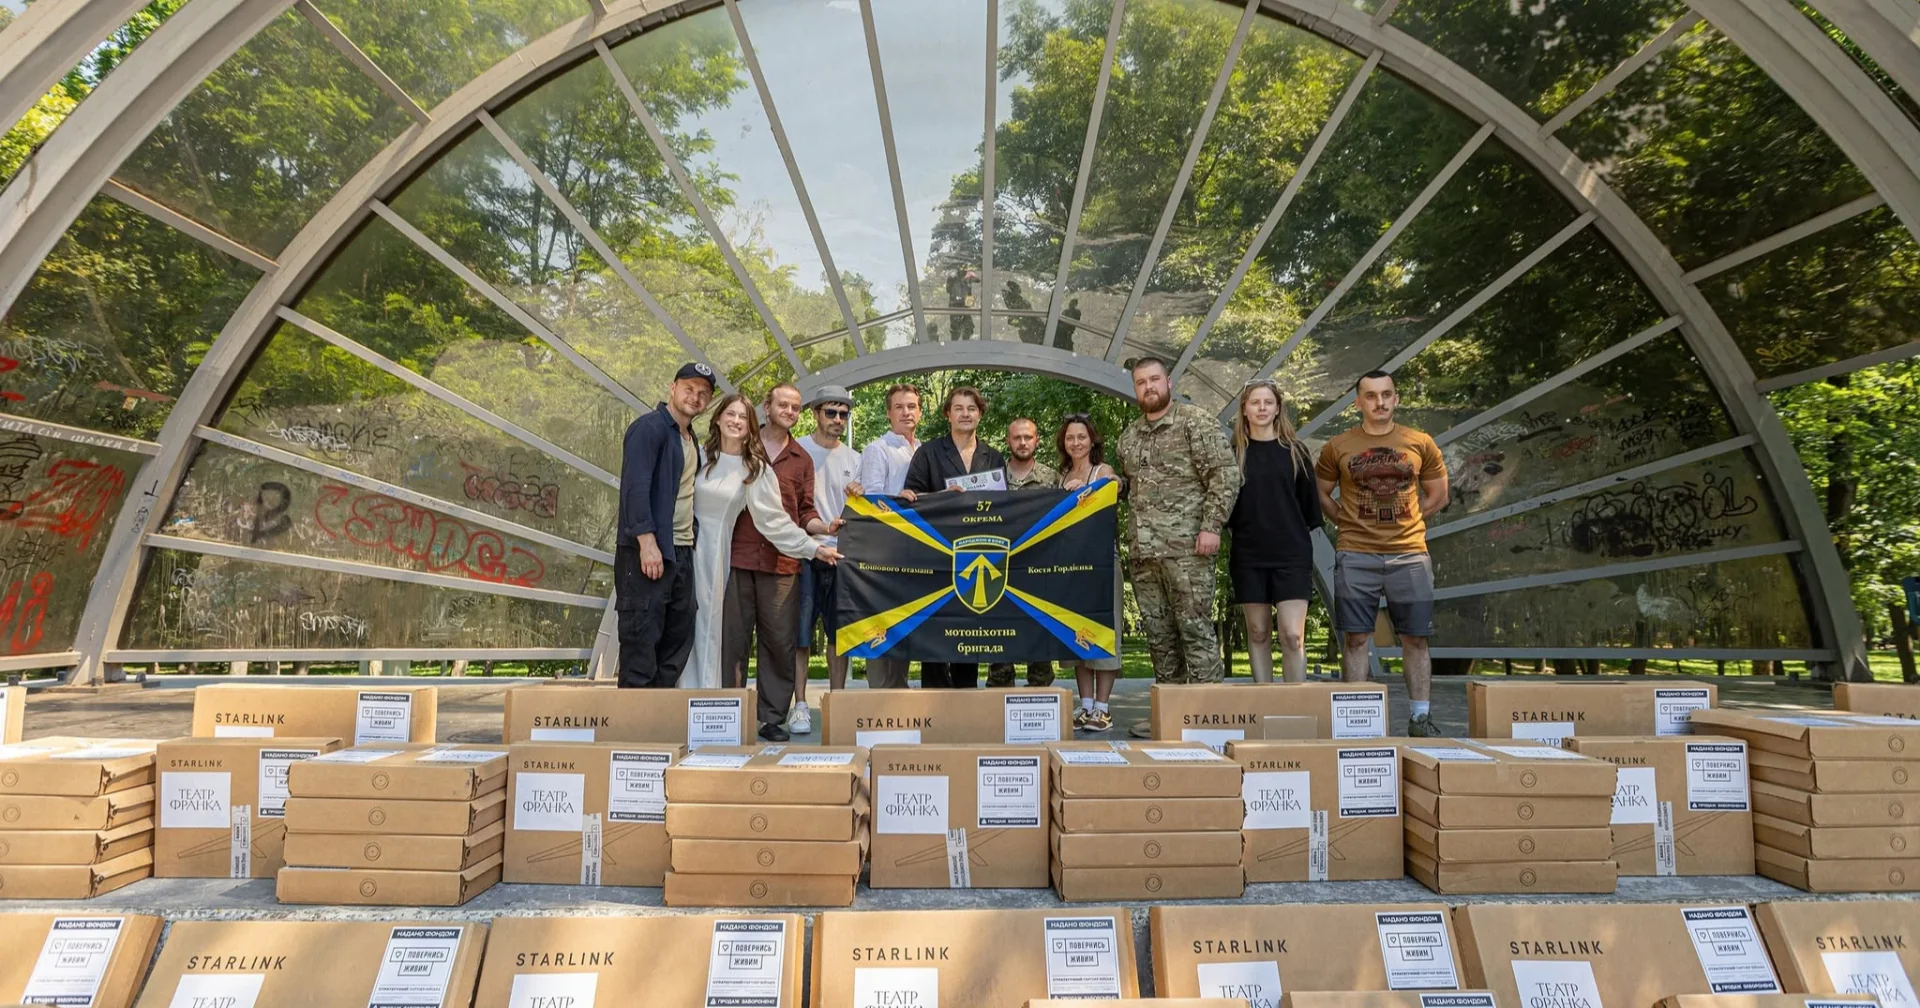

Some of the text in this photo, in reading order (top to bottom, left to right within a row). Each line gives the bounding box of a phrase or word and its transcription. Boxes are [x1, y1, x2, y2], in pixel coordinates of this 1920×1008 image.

[976, 501, 992, 512] 57
[962, 516, 1003, 524] ОКРЕМА
[859, 562, 900, 573] Кошового
[1028, 564, 1093, 574] Костя Гордієнка
[944, 627, 1016, 637] мотопіхотна
[957, 642, 1004, 655] бригада
[215, 713, 285, 725] STARLINK
[1183, 714, 1257, 725] STARLINK
[1512, 711, 1585, 721] STARLINK
[534, 718, 610, 727] STARLINK
[856, 717, 932, 728] STARLINK
[524, 761, 575, 771] STARLINK
[888, 763, 941, 771] STARLINK
[1250, 761, 1300, 769] STARLINK
[178, 789, 215, 800] ТЕАТР
[532, 790, 568, 801] ТЕАТР
[1258, 789, 1294, 800] ТЕАТР
[1614, 785, 1640, 796] АТР
[894, 793, 931, 804] ТЕАТР
[1613, 796, 1648, 807] АНКА
[170, 800, 222, 811] ФРАНКА
[522, 800, 574, 813] ФРАНКА
[885, 804, 938, 816] ФРАНКА
[1250, 800, 1301, 811] ФРАНКА
[1193, 940, 1288, 953] STARLINK
[1510, 942, 1604, 954] STARLINK
[1815, 937, 1908, 950] STARLINK
[852, 948, 951, 960] STARLINK
[188, 956, 288, 970] STARLINK
[516, 953, 615, 967] STARLINK
[1848, 974, 1889, 990] ТЕАТР
[1219, 985, 1262, 998] ТЕАТР
[1536, 982, 1579, 997] ТЕАТР
[192, 997, 236, 1008] ТЕАТР
[530, 997, 575, 1008] ТЕАТР
[874, 991, 919, 1004] ТЕАТР
[1530, 996, 1597, 1008] ФРАНКА
